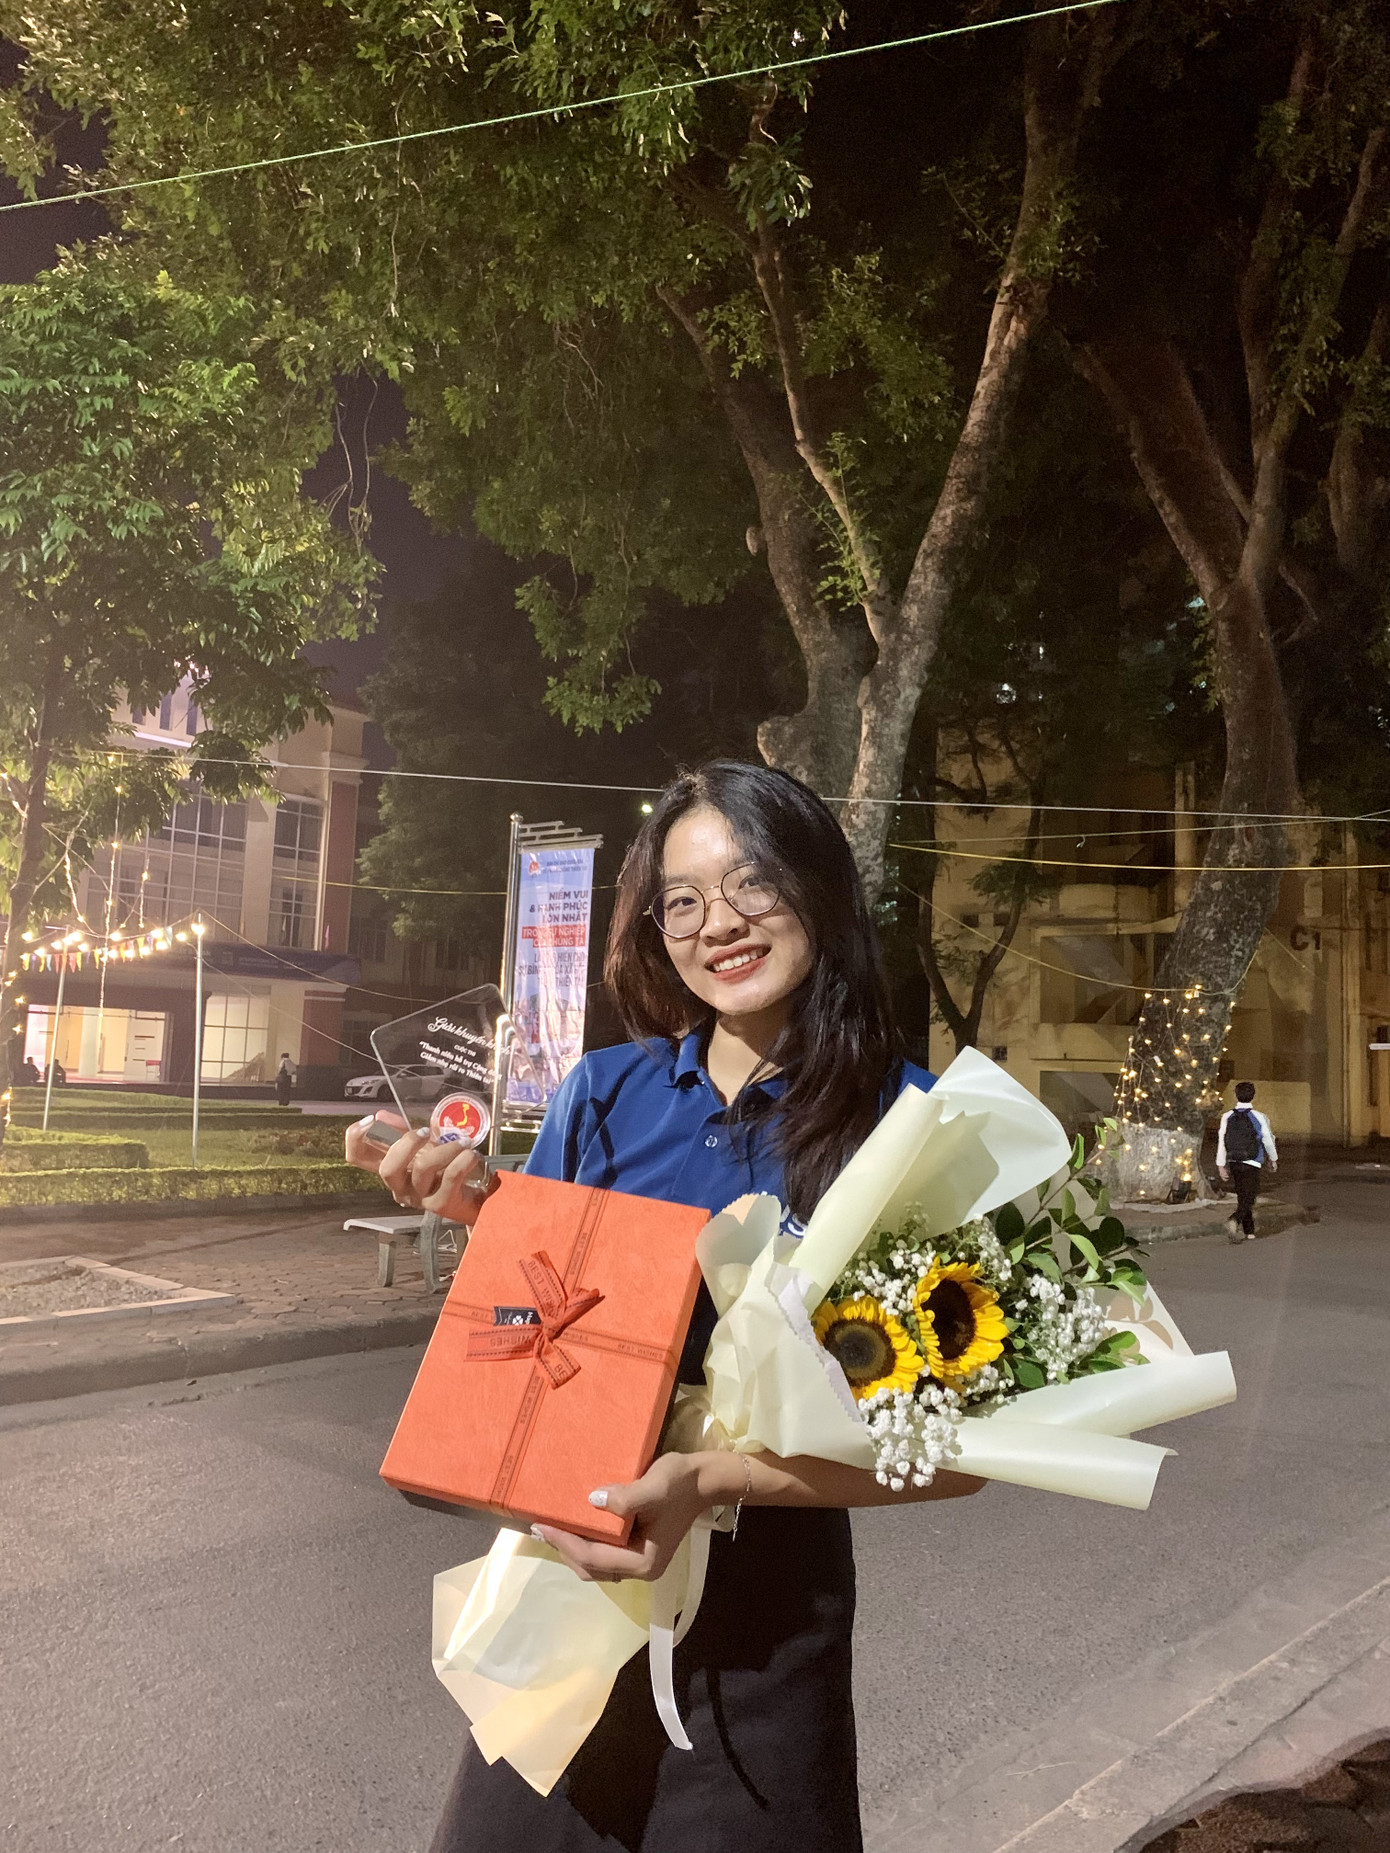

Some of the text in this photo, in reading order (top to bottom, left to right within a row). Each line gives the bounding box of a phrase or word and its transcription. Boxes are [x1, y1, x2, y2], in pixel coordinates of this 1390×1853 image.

[573, 890, 588, 899] VUI
[529, 904, 536, 913] &
[575, 937, 585, 945] TA
[1290, 925, 1321, 951] C1
[427, 1016, 456, 1032] Giải
[528, 1260, 544, 1285] BEST
